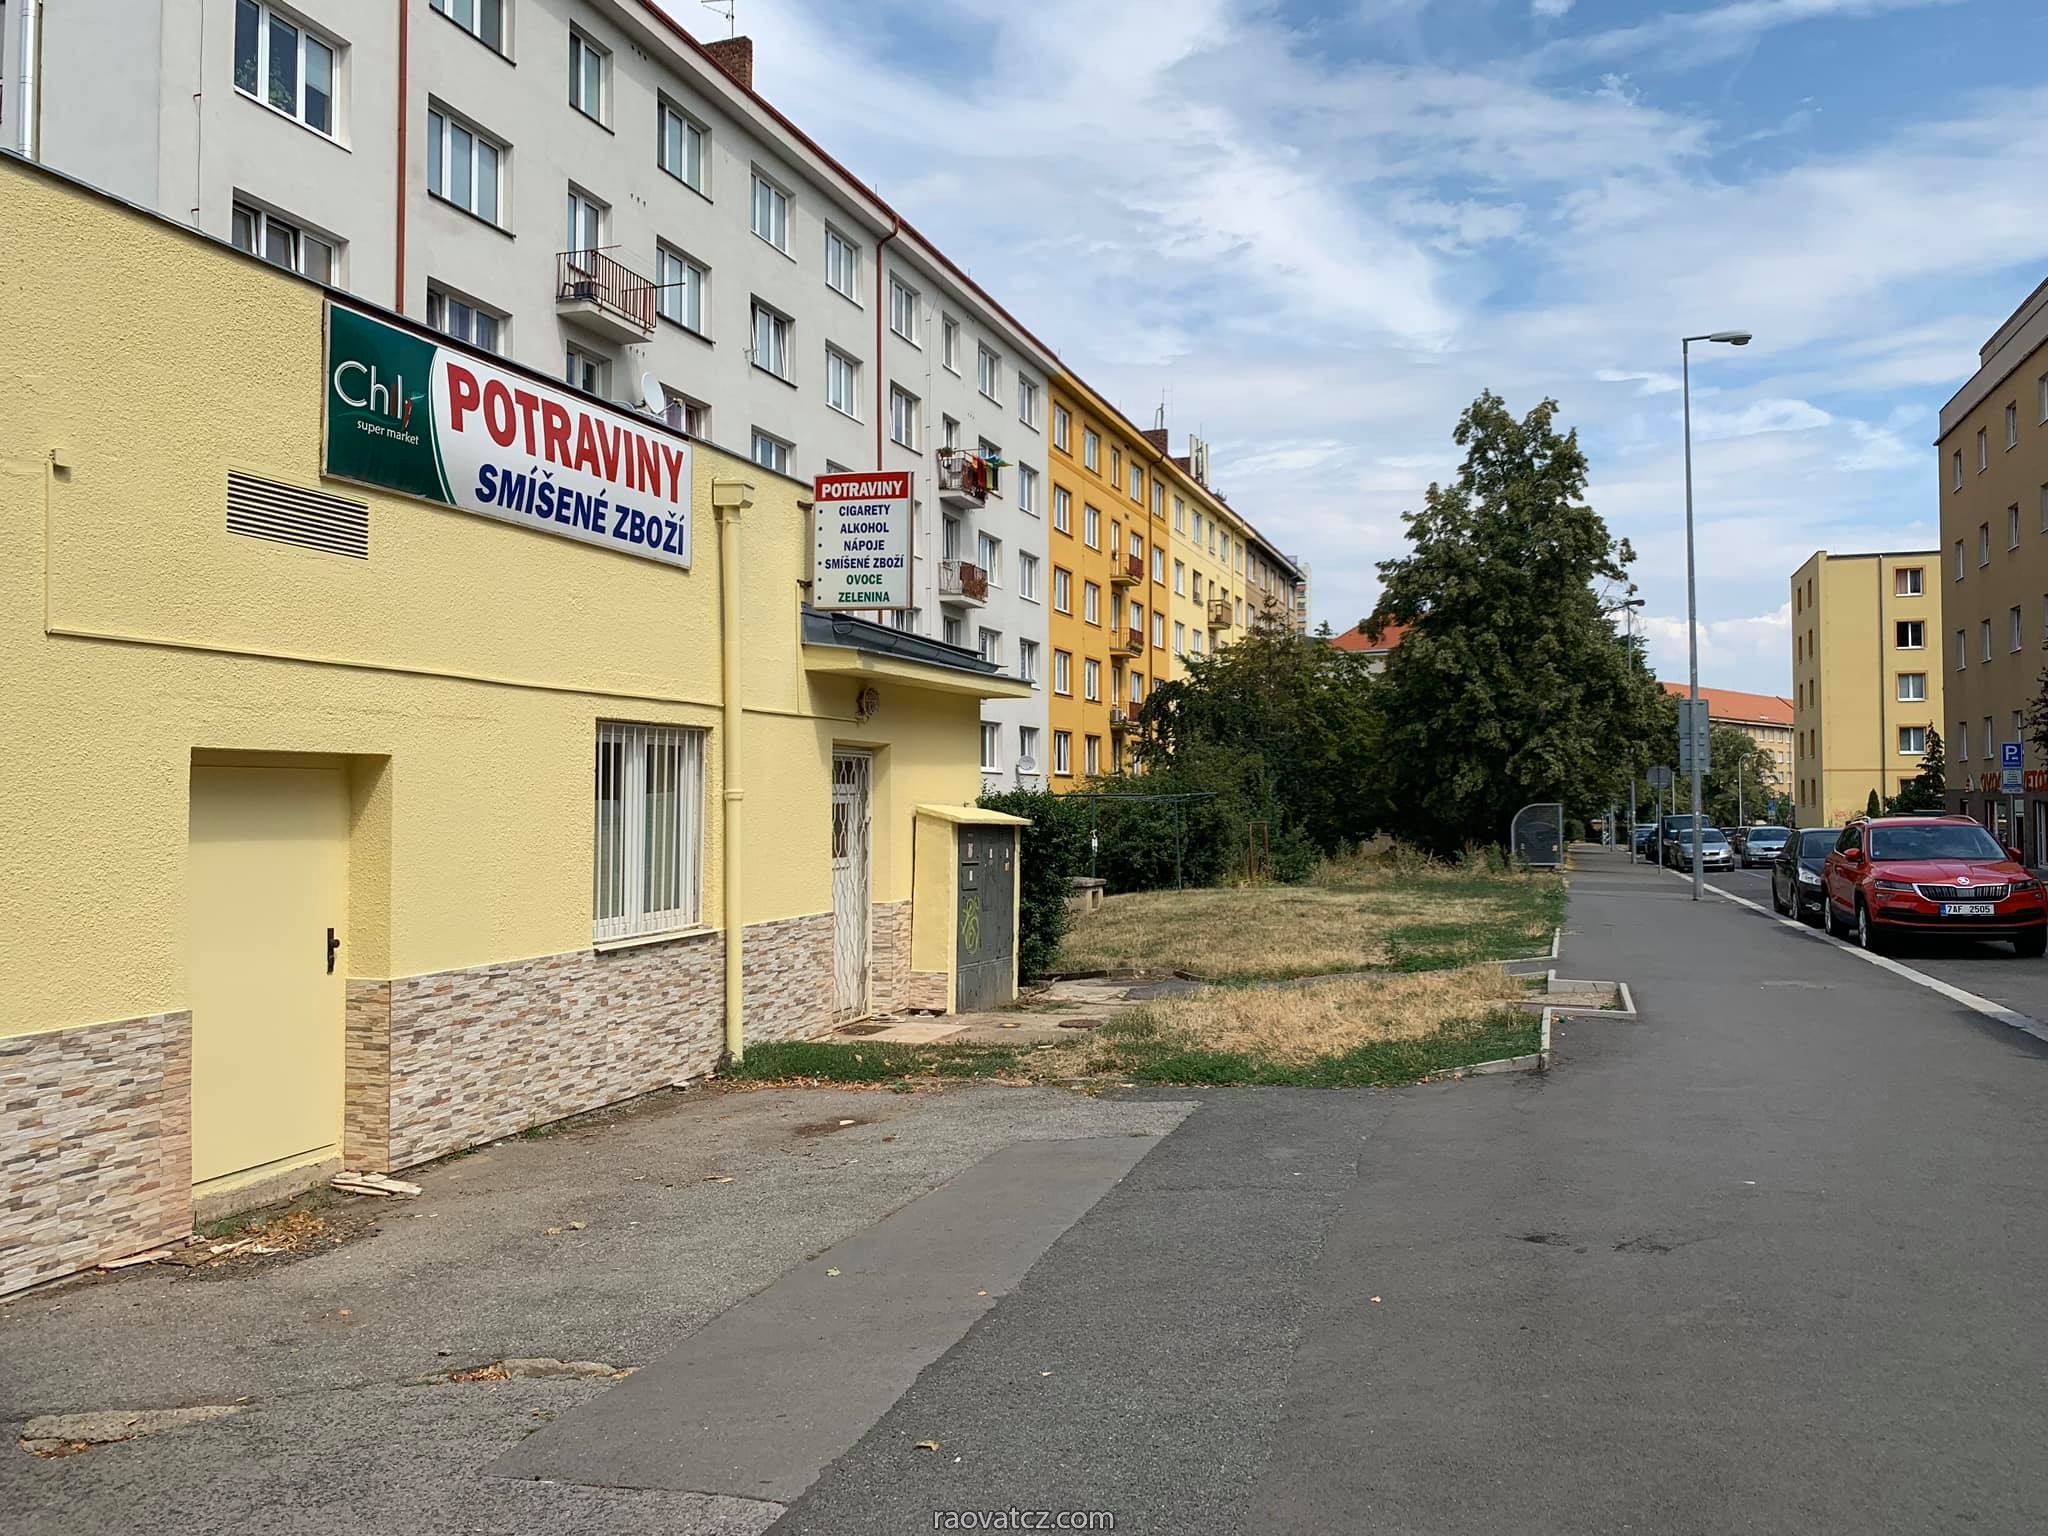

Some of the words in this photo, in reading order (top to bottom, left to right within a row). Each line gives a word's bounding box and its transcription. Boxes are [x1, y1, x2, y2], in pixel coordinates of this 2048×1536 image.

[356, 420, 385, 435] super
[386, 427, 419, 446] market
[446, 362, 684, 504] POTRAVINY
[821, 480, 904, 498] POTRAVINY
[475, 463, 609, 535] SMÍŠENÉ
[612, 510, 685, 556] ZBOŽÍ
[839, 504, 891, 517] CIGARETY
[839, 522, 890, 534] ALKOHOL
[843, 537, 885, 551] NÁPOJE
[825, 554, 870, 569] SMÍŠENÉ
[872, 553, 905, 569] ZBOŽÍ
[846, 574, 883, 585] OVOCE
[838, 591, 890, 603] ZELENINA
[2005, 745, 2018, 761] P
[1947, 905, 1963, 913] 7AF
[1969, 905, 1991, 913] 2505
